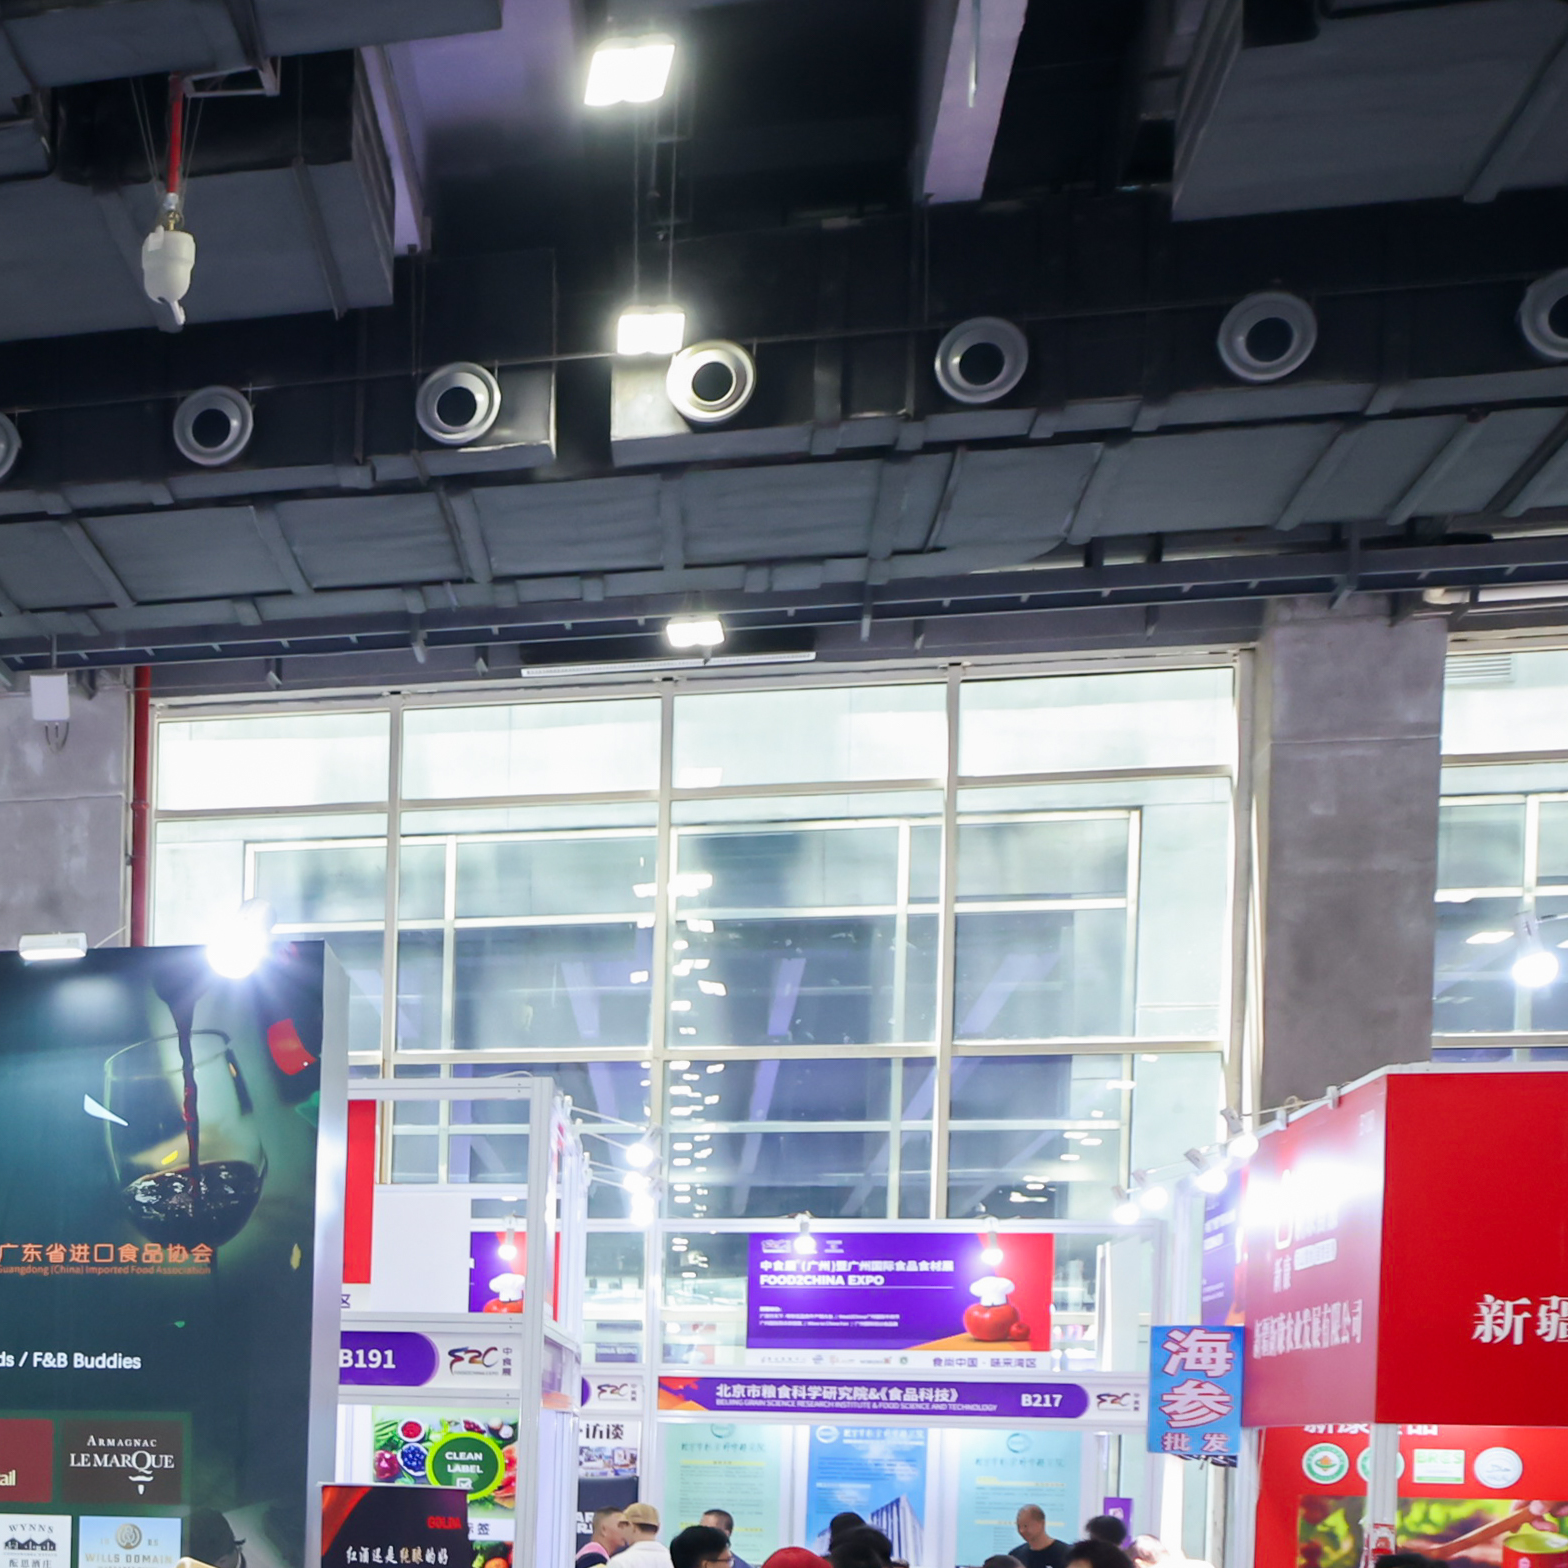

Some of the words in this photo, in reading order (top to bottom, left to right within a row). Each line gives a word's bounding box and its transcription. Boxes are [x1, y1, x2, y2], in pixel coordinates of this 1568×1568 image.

[86, 1266, 129, 1277] Imported
[131, 1266, 154, 1275] Food
[760, 1275, 845, 1286] FOOD2CHINA
[848, 1275, 885, 1286] EXPO
[33, 1352, 68, 1369] F&B
[73, 1353, 142, 1370] Buddies
[339, 1349, 396, 1369] B191
[1161, 1328, 1235, 1429] 海参
[1021, 1393, 1062, 1408] B217
[87, 1434, 157, 1448] ARMAGNAC
[1162, 1432, 1230, 1452] 批发
[445, 1451, 483, 1462] CLEAN
[447, 1463, 484, 1474] LABEL
[9, 1523, 54, 1533] WYNNS
[427, 1516, 462, 1530] GOLDA
[85, 1553, 120, 1563] WILLS
